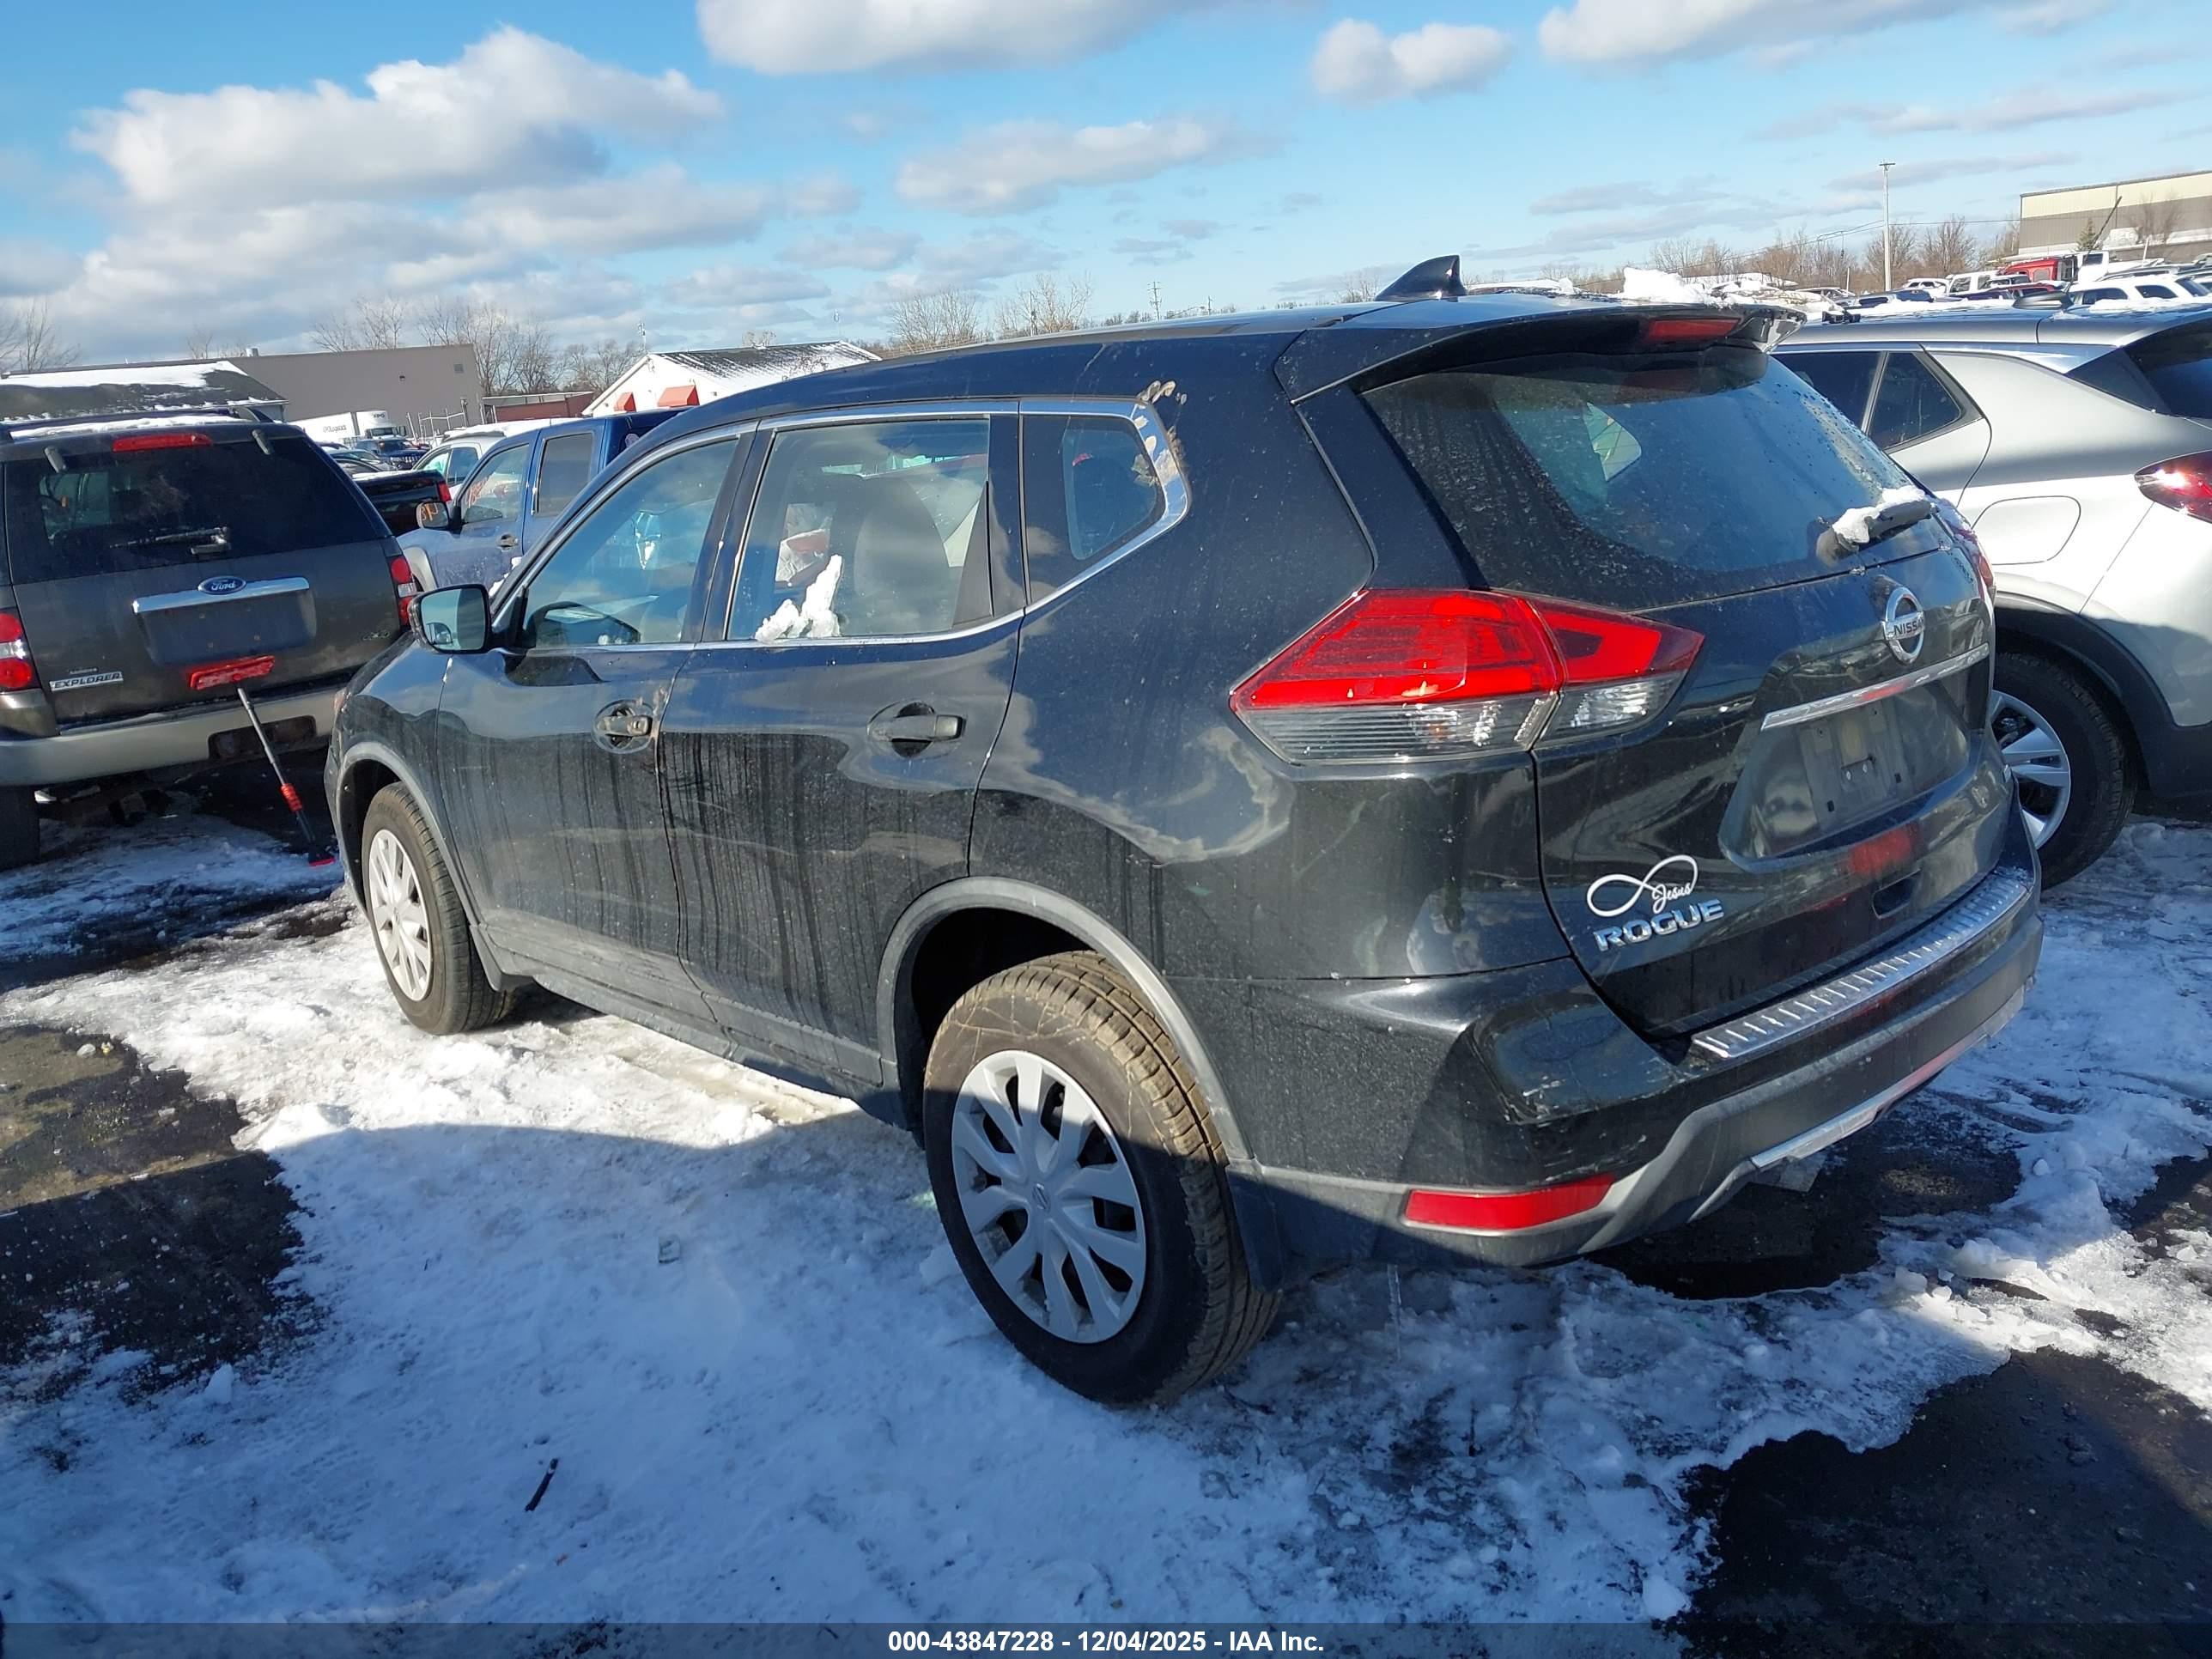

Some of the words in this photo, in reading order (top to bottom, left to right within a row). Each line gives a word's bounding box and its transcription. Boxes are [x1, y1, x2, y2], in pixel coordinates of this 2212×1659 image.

[210, 580, 236, 591] Ford
[1893, 618, 1923, 635] NISSA
[54, 672, 121, 688] EXPLORER
[1651, 883, 1692, 914] Jesus
[1593, 898, 1725, 951] ROGUE
